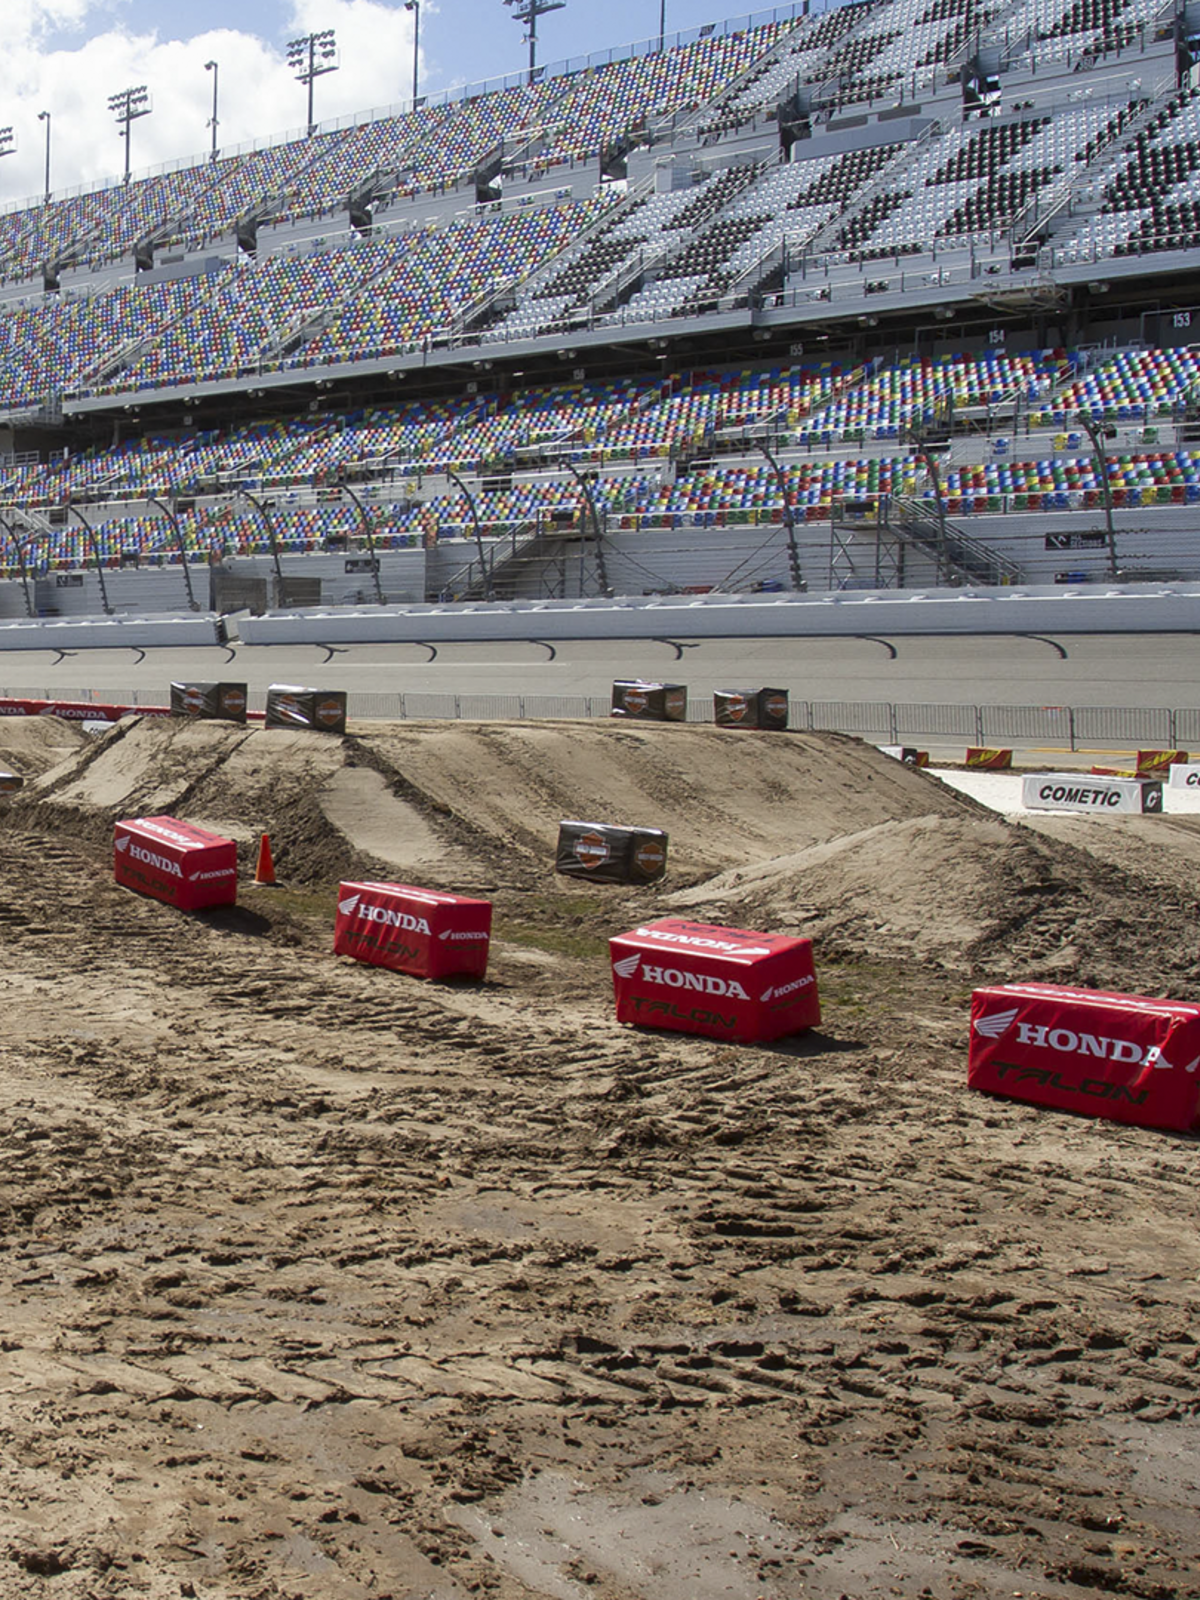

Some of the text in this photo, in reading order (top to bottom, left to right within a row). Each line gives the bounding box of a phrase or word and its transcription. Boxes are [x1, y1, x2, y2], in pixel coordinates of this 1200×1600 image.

[1173, 312, 1191, 327] 153
[988, 329, 1004, 343] 154
[790, 344, 803, 356] 155
[55, 709, 107, 719] HONDA
[1039, 785, 1122, 807] COMETIC
[129, 843, 184, 879] HONDA
[199, 868, 235, 880] HONDA
[357, 903, 432, 936] HONDA
[344, 930, 420, 960] TALON
[450, 931, 489, 941] HONDA
[641, 964, 751, 1001] HONDA
[774, 974, 814, 998] HONDA
[629, 996, 738, 1028] TALON
[1015, 1021, 1174, 1069] HONDA
[990, 1060, 1150, 1105] TALON
